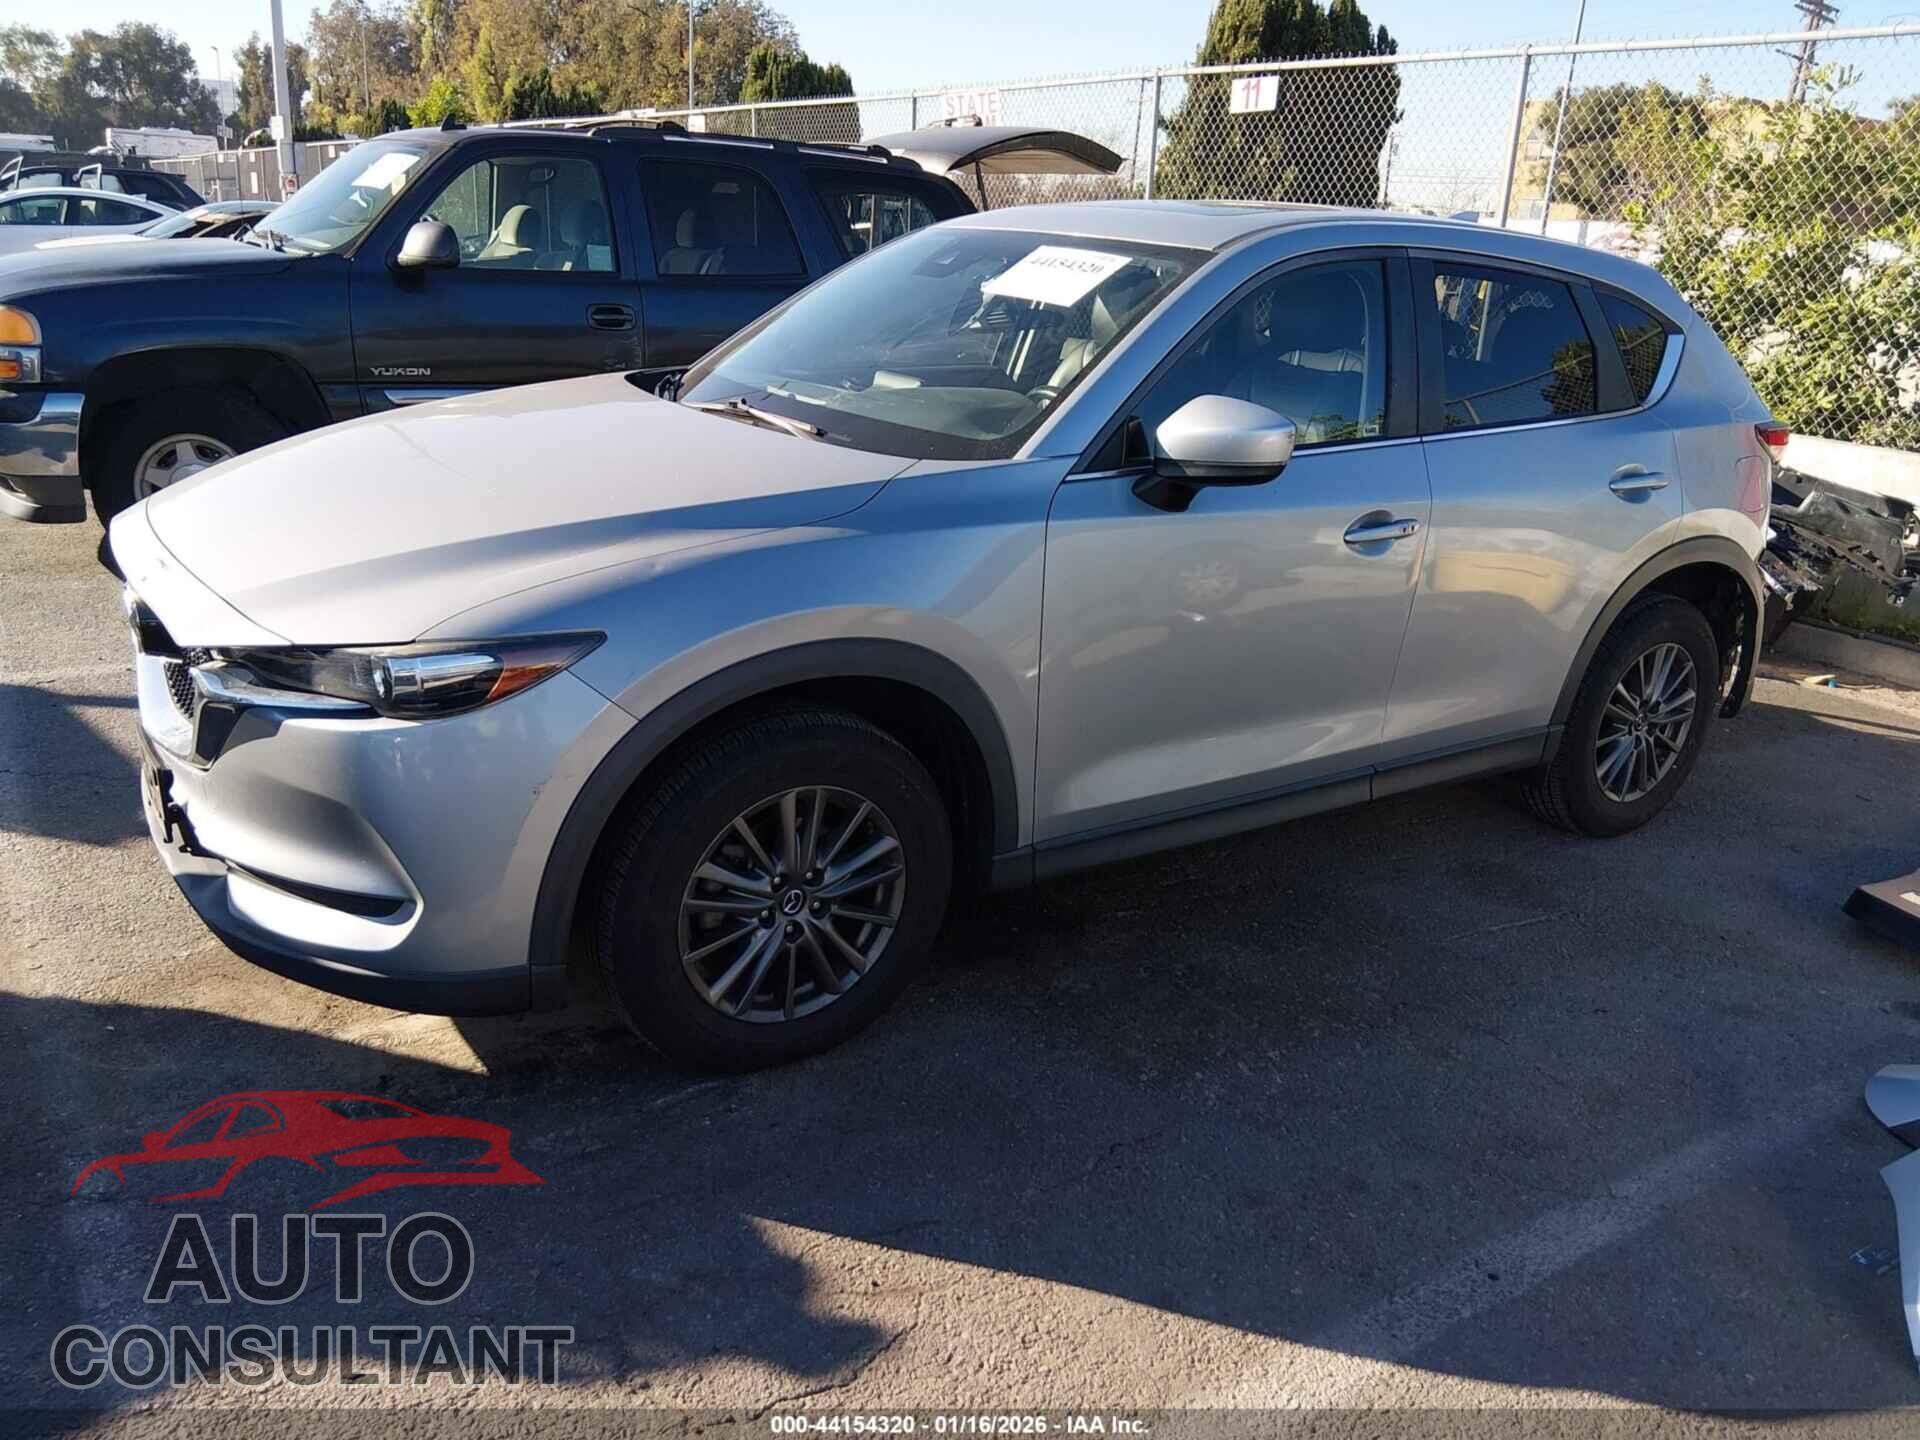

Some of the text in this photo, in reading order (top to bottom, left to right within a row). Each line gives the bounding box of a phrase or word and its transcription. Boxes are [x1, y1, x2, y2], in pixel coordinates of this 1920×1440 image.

[945, 91, 998, 116] STATE
[1242, 79, 1261, 110] 11
[369, 367, 432, 376] YUKON
